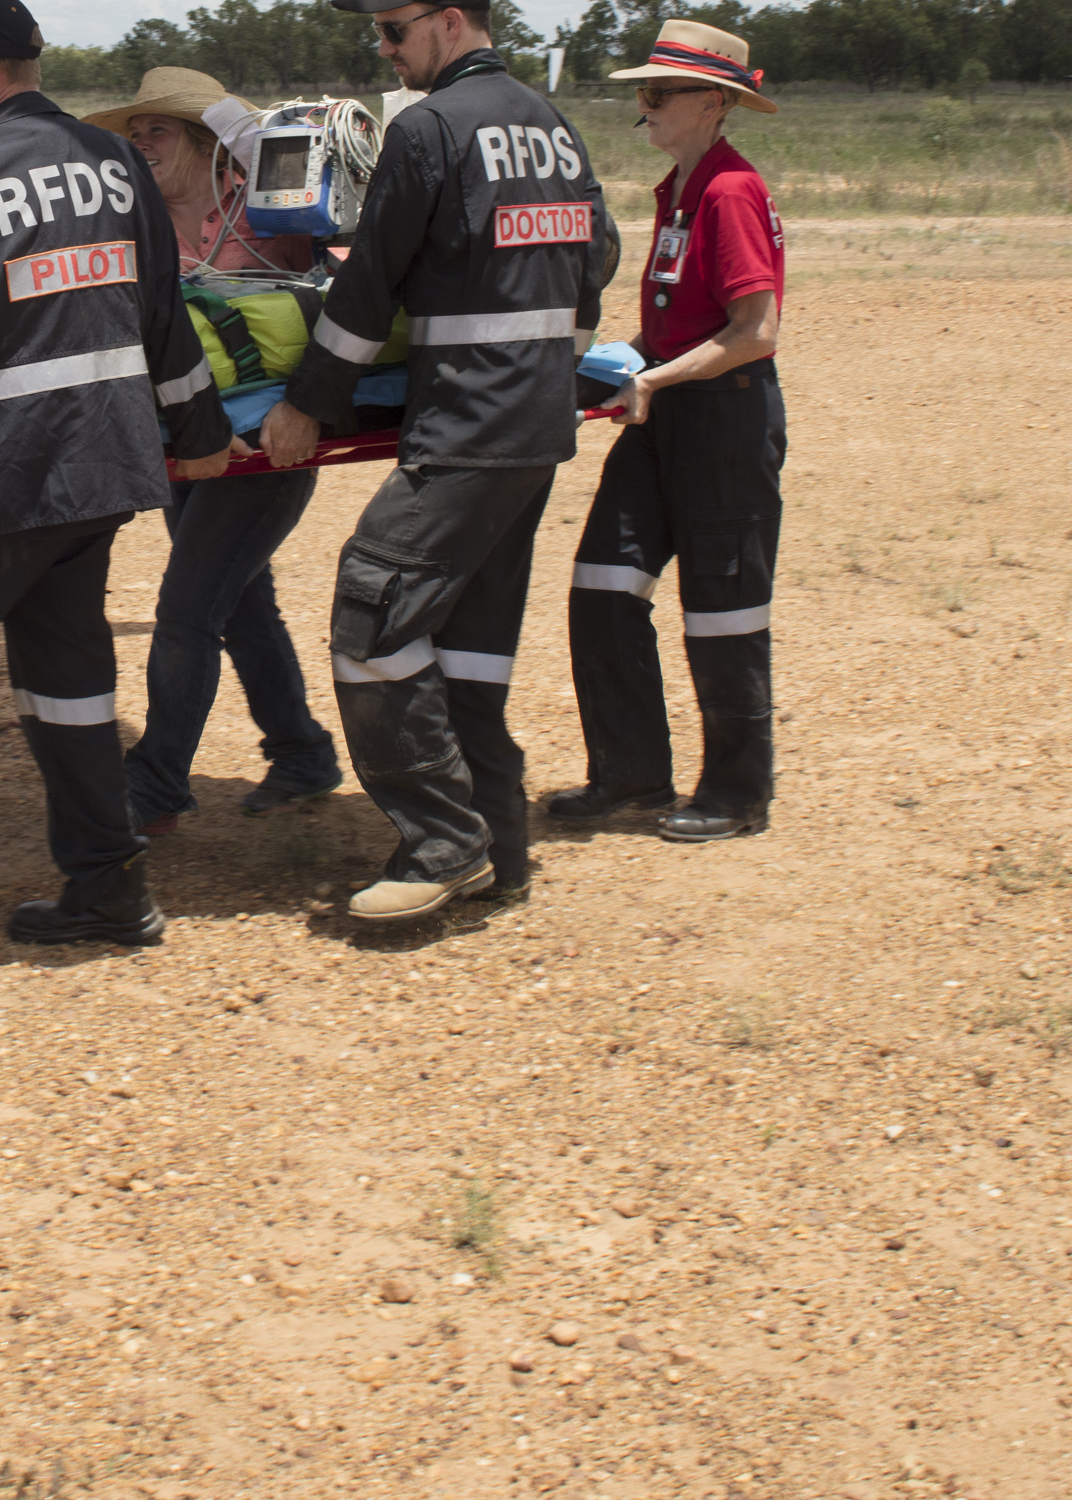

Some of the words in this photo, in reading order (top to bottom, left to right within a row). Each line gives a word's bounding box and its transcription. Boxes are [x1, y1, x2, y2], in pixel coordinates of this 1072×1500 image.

[476, 124, 582, 182] RFDS
[499, 208, 587, 241] DOCTOR
[30, 247, 127, 291] PILOT
